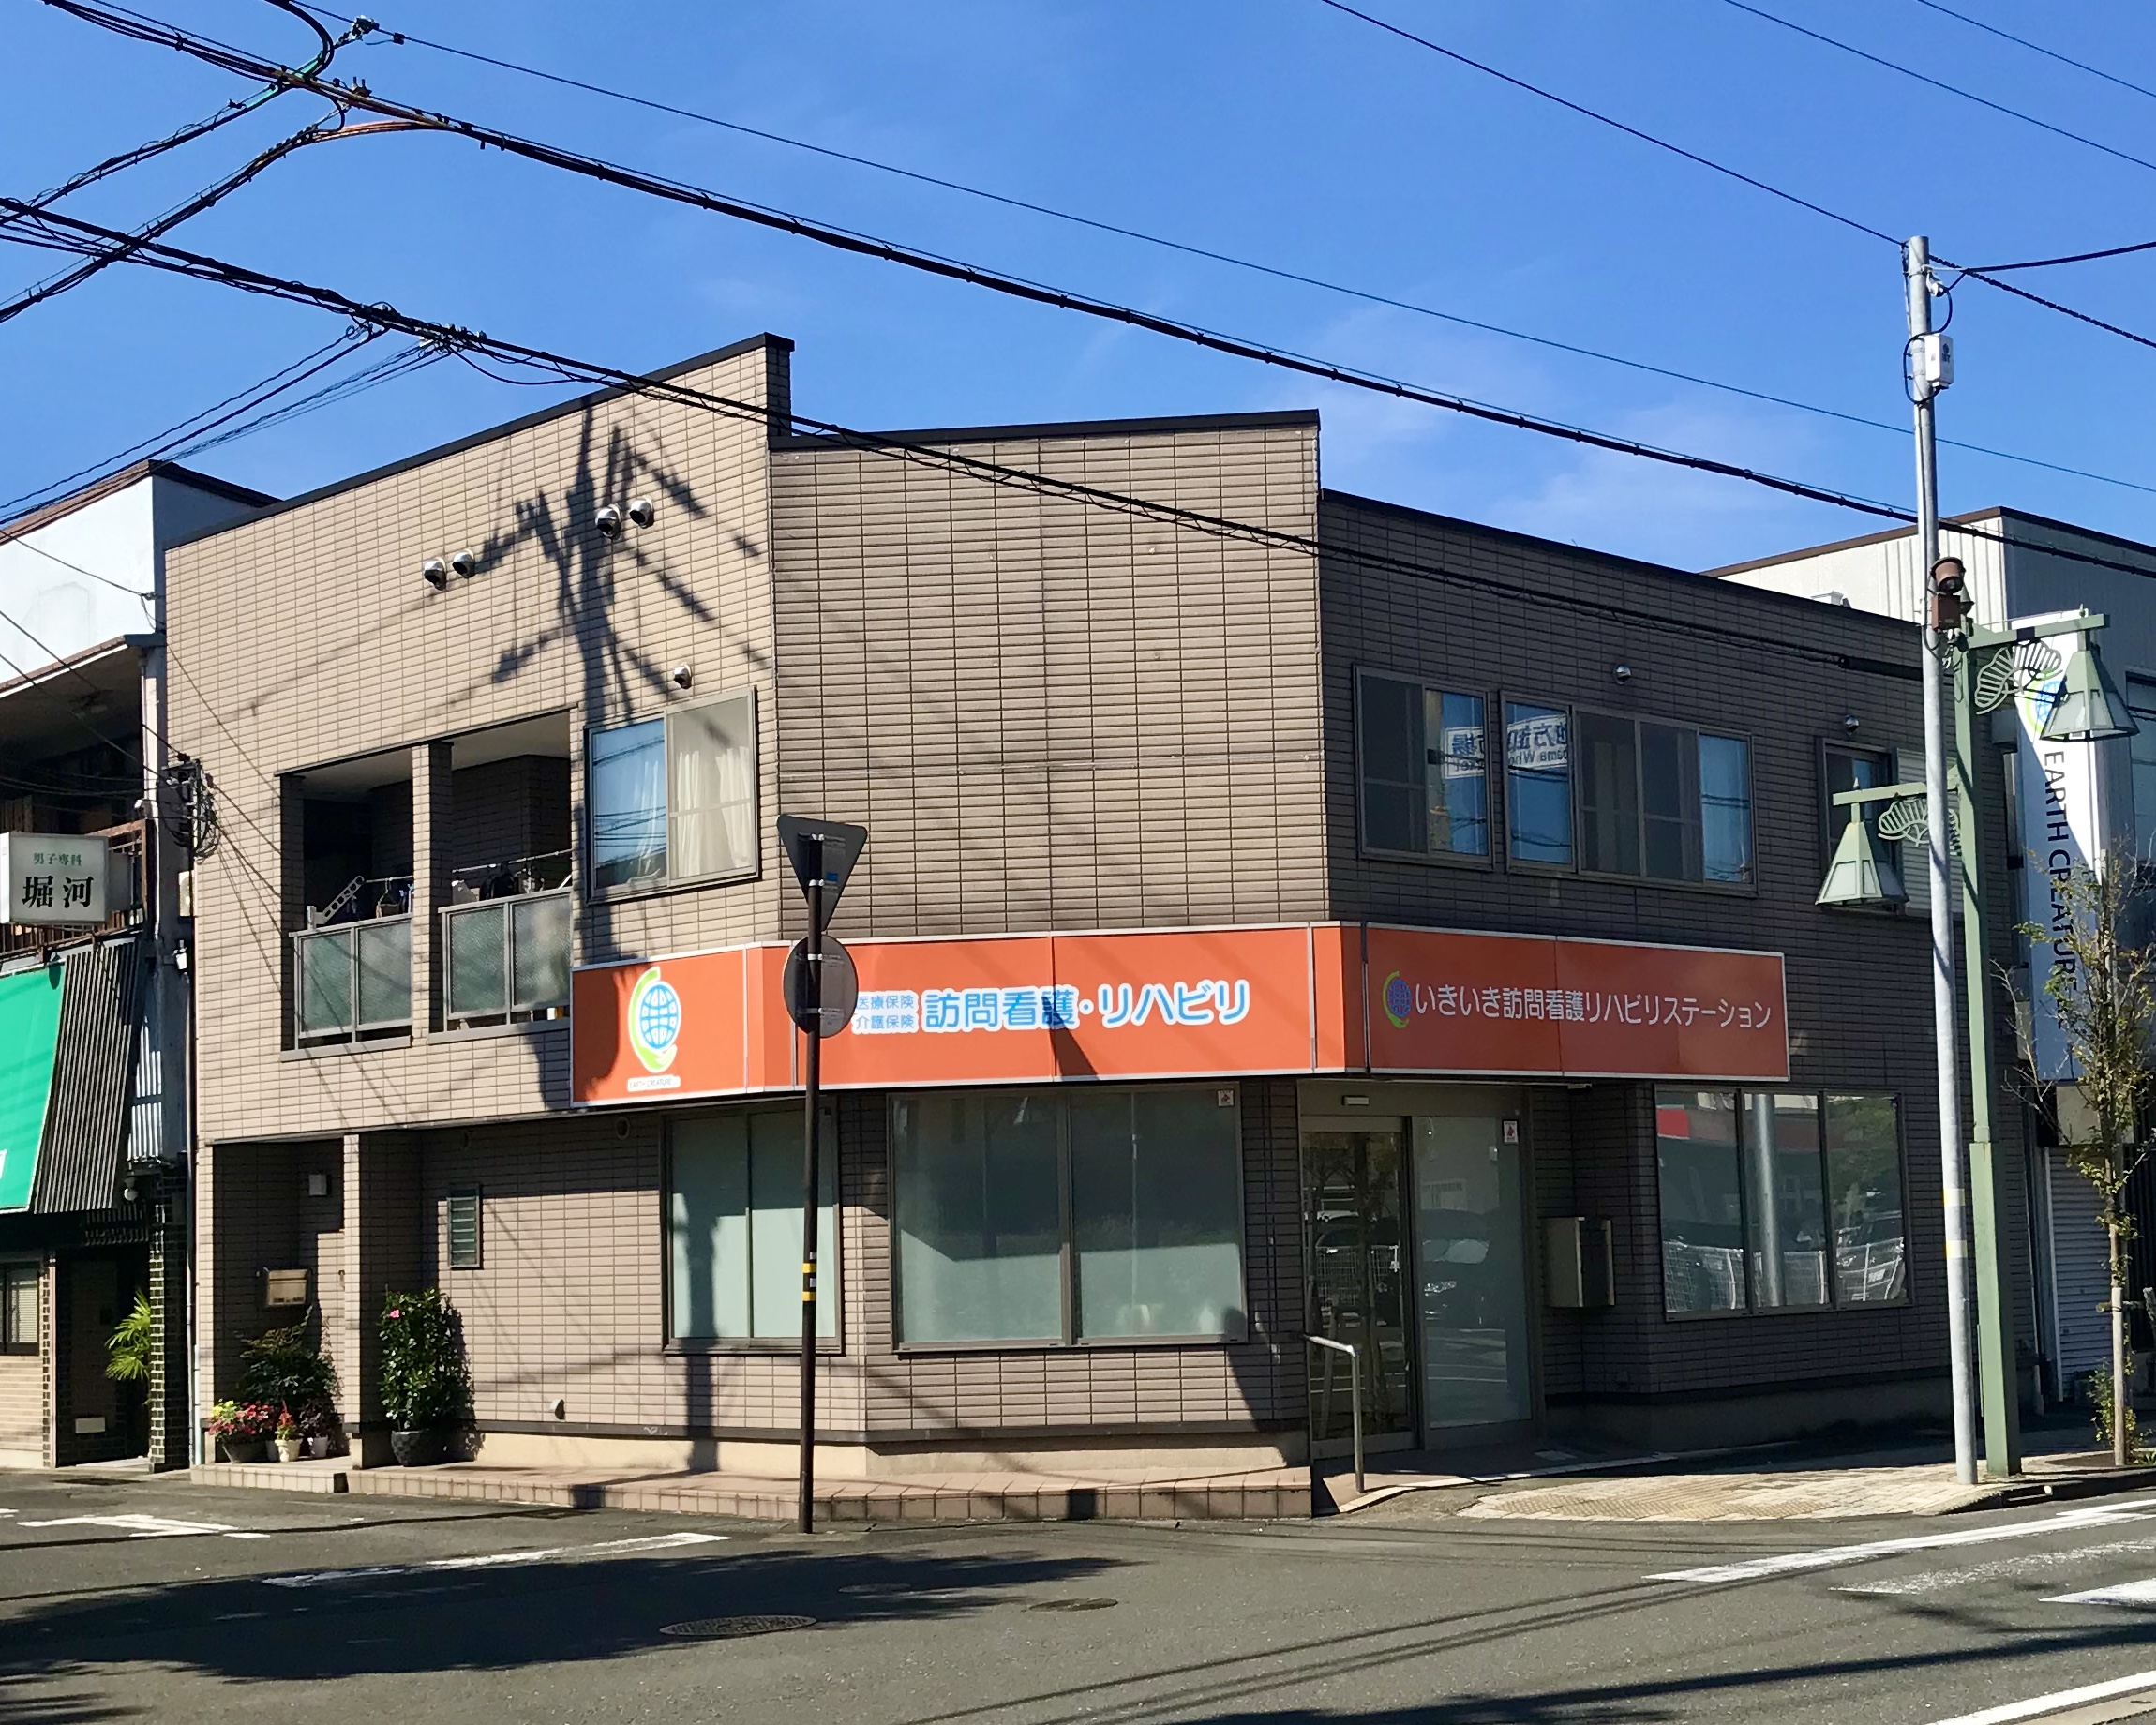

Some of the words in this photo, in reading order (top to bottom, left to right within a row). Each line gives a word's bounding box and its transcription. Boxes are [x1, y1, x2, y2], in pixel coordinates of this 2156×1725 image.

[2044, 751, 2069, 842] EARTH
[22, 875, 94, 909] 堀河
[856, 995, 915, 1011] 医療保険
[1415, 983, 1772, 1029] いきいき訪問看護リハビリステーション
[855, 1014, 915, 1030] 介護保険
